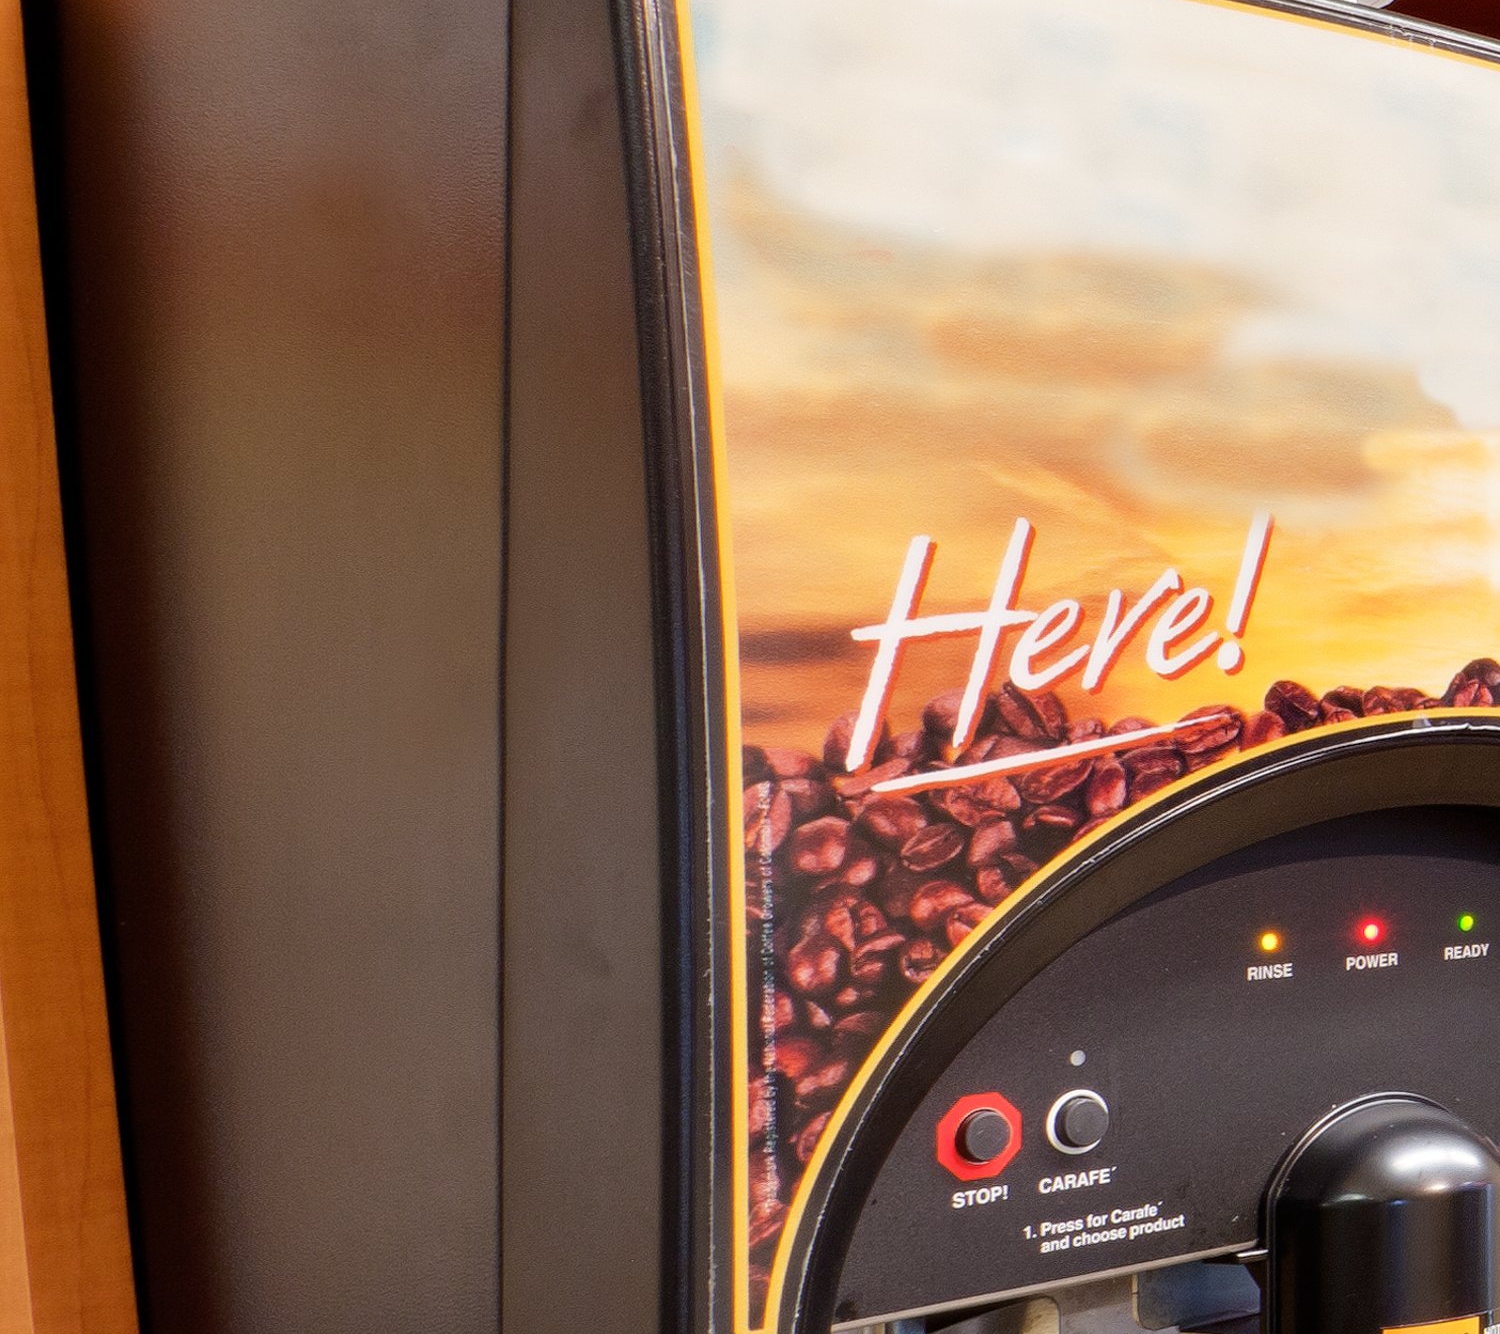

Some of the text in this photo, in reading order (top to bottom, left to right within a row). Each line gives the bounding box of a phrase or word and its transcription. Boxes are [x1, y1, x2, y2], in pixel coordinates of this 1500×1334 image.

[850, 511, 1275, 776] Here!
[1246, 942, 1490, 981] RINSE POWER READY
[952, 1185, 1009, 1209] STOP!
[1023, 1225, 1037, 1240] 1.
[1040, 1219, 1083, 1237] Press
[1086, 1214, 1108, 1229] for
[1040, 1214, 1185, 1254] and choose product
